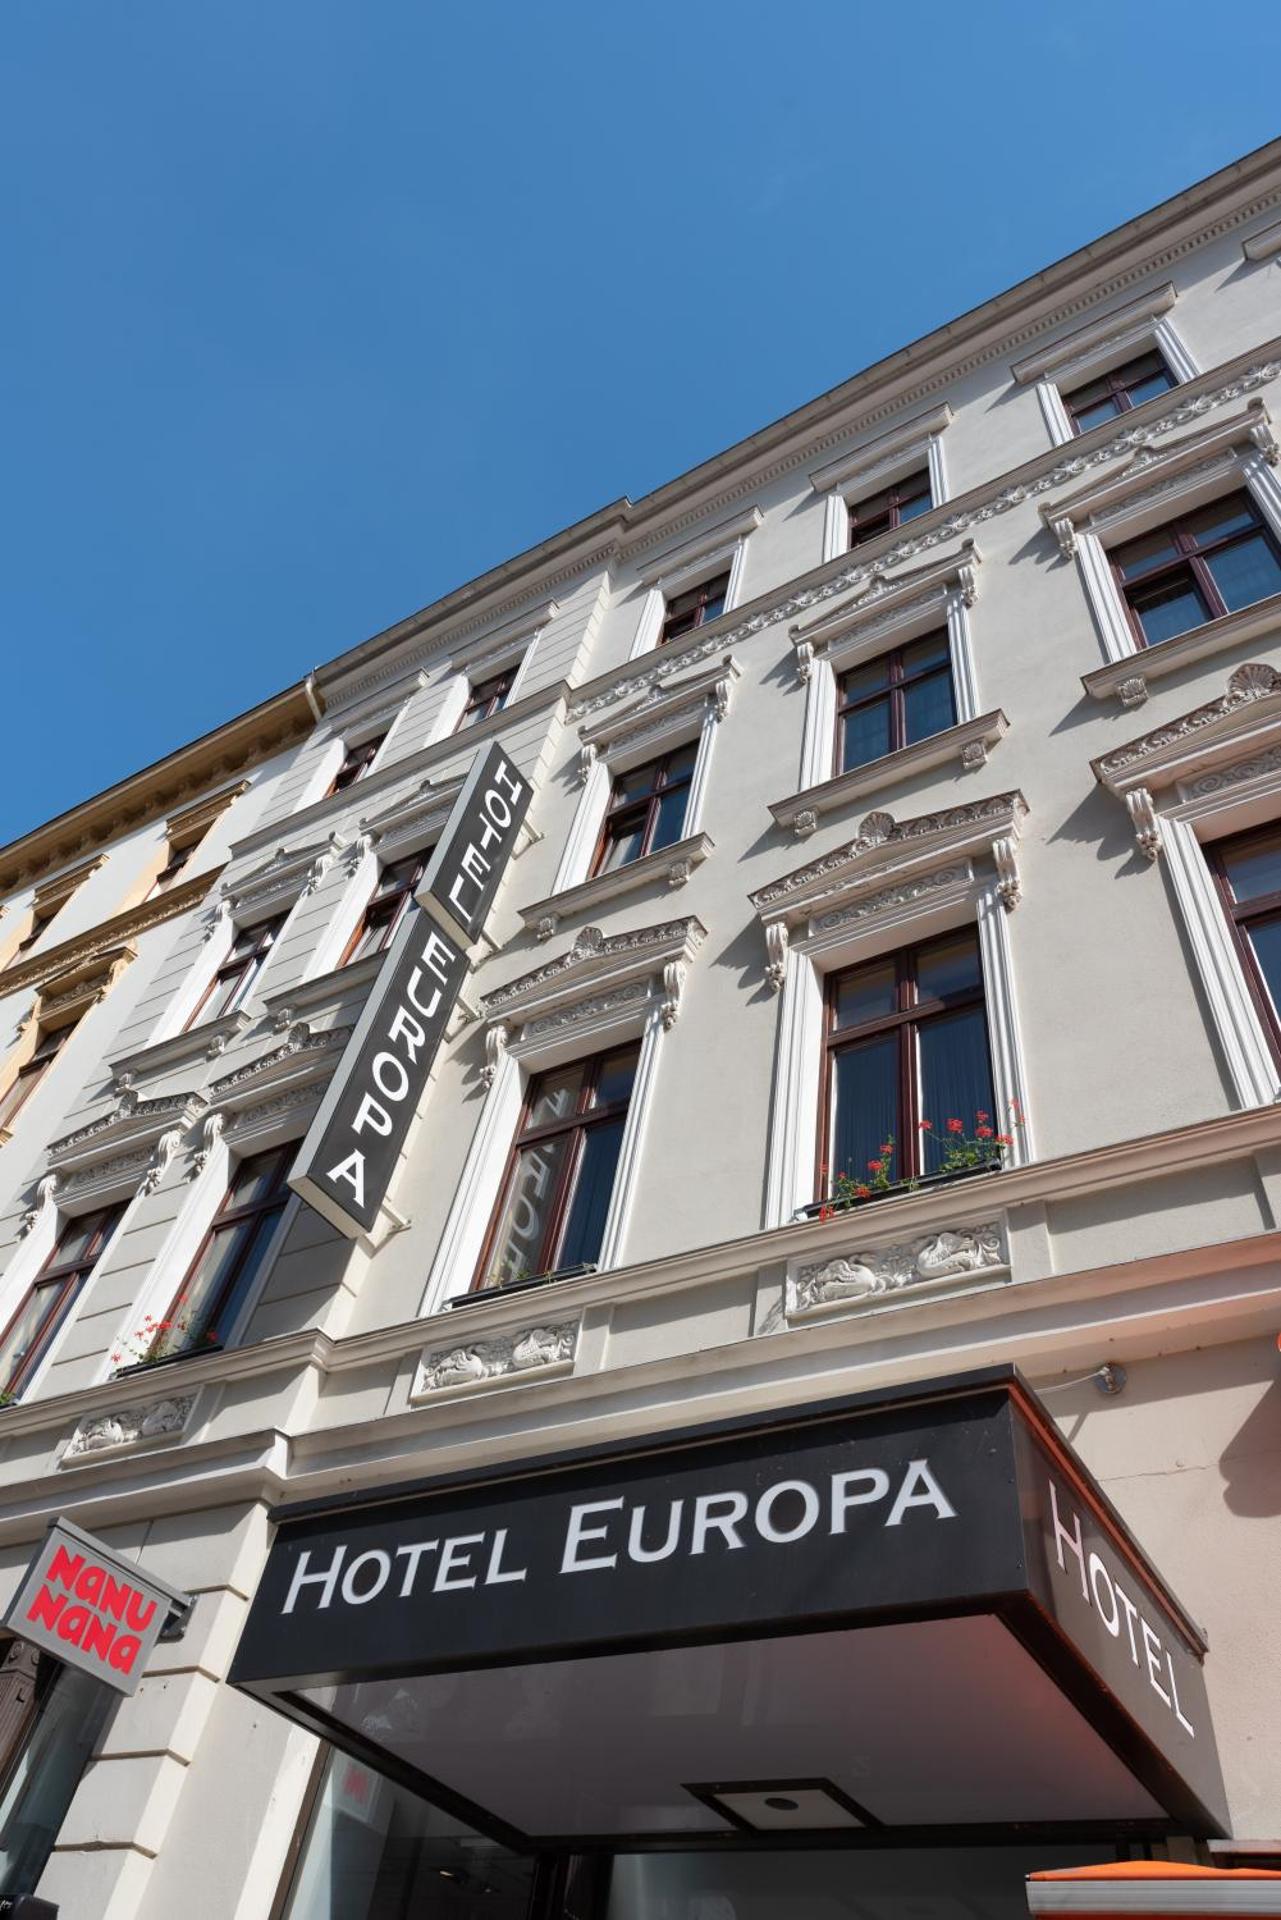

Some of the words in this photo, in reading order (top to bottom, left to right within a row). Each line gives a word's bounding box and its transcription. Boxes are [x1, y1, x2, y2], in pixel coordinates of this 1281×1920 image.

[447, 759, 523, 924] HOTEL
[326, 931, 456, 1209] EUROPA
[281, 1528, 527, 1615] HOTEL
[558, 1458, 957, 1574] EUROPA
[1048, 1479, 1195, 1739] HOTEL
